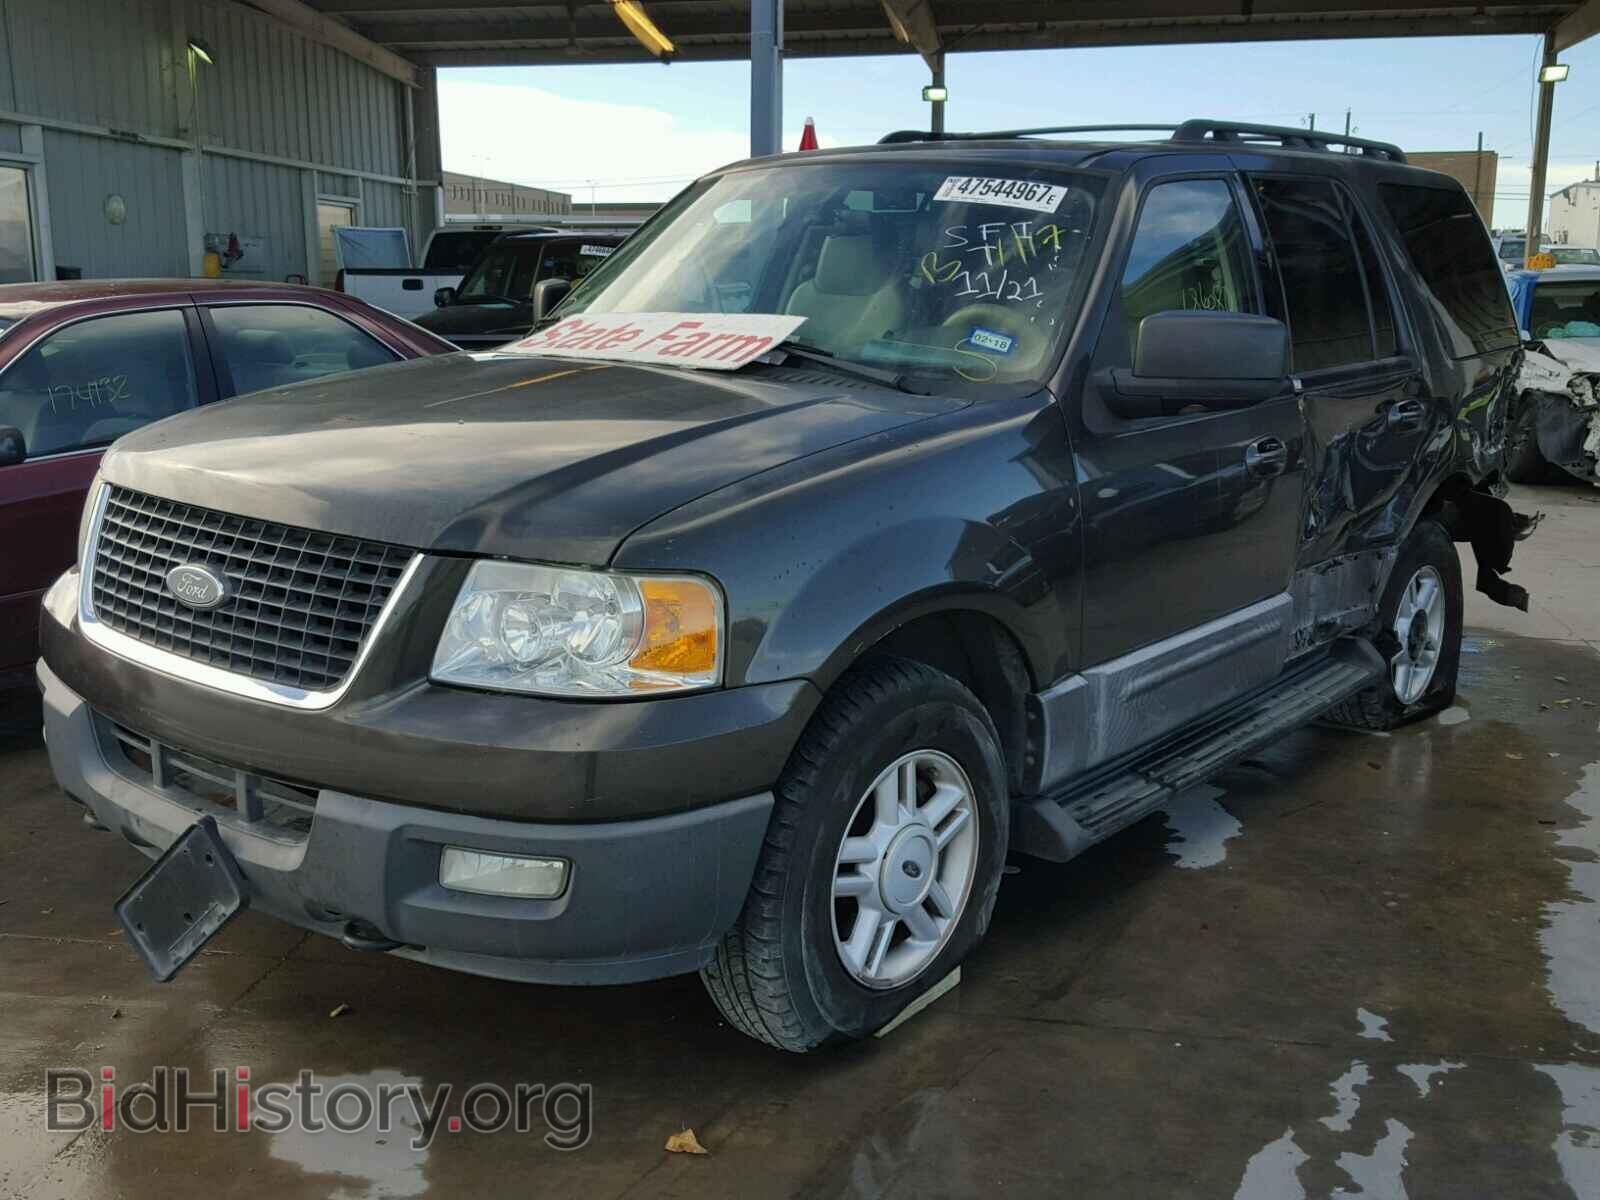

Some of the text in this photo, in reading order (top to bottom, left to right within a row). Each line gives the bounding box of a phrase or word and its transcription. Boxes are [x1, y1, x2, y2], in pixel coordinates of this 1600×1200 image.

[958, 178, 1053, 202] 47544967
[952, 269, 1044, 300] 11/21
[518, 319, 774, 363] State Farm
[176, 572, 209, 600] Ford
